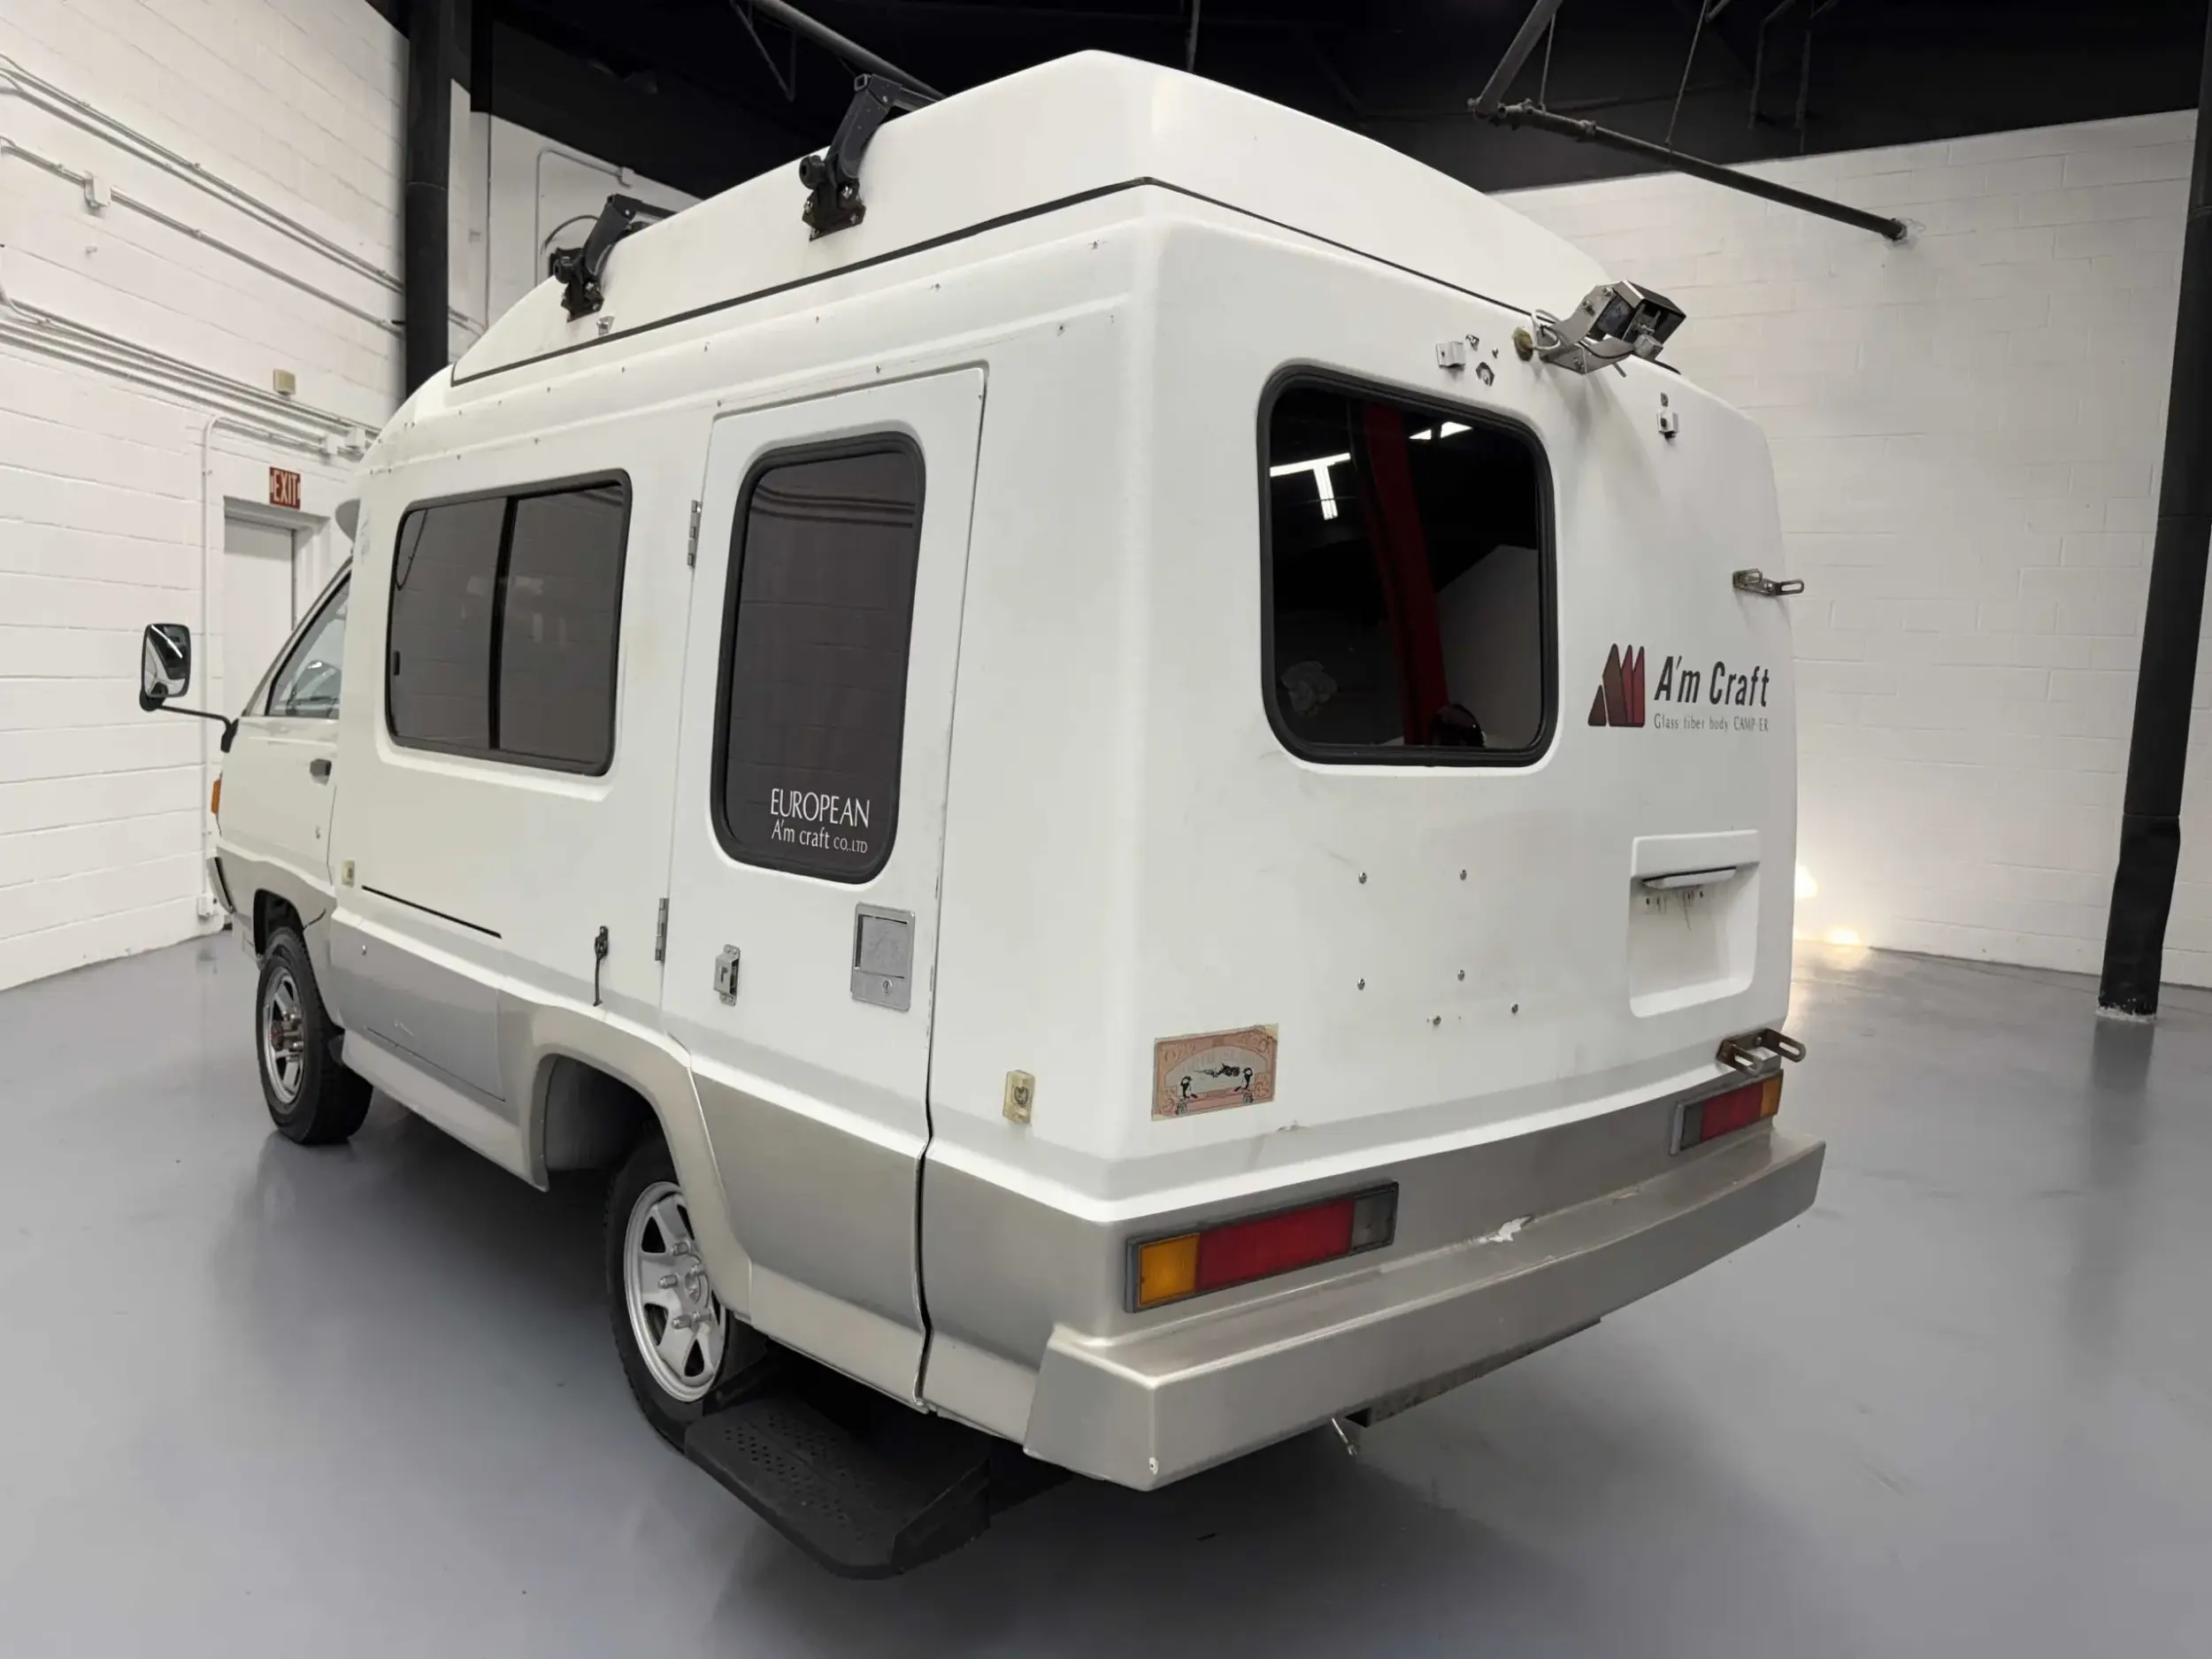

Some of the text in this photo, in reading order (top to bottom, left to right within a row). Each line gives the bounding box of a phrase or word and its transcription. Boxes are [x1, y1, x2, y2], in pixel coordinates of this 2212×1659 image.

[273, 470, 298, 506] EXIT
[1654, 656, 1769, 707] A'm Craft
[1654, 712, 1678, 729] Glass
[1709, 715, 1728, 733] body
[771, 787, 870, 828] EUROPEAN
[772, 818, 795, 842] A'm
[799, 826, 830, 849] craft
